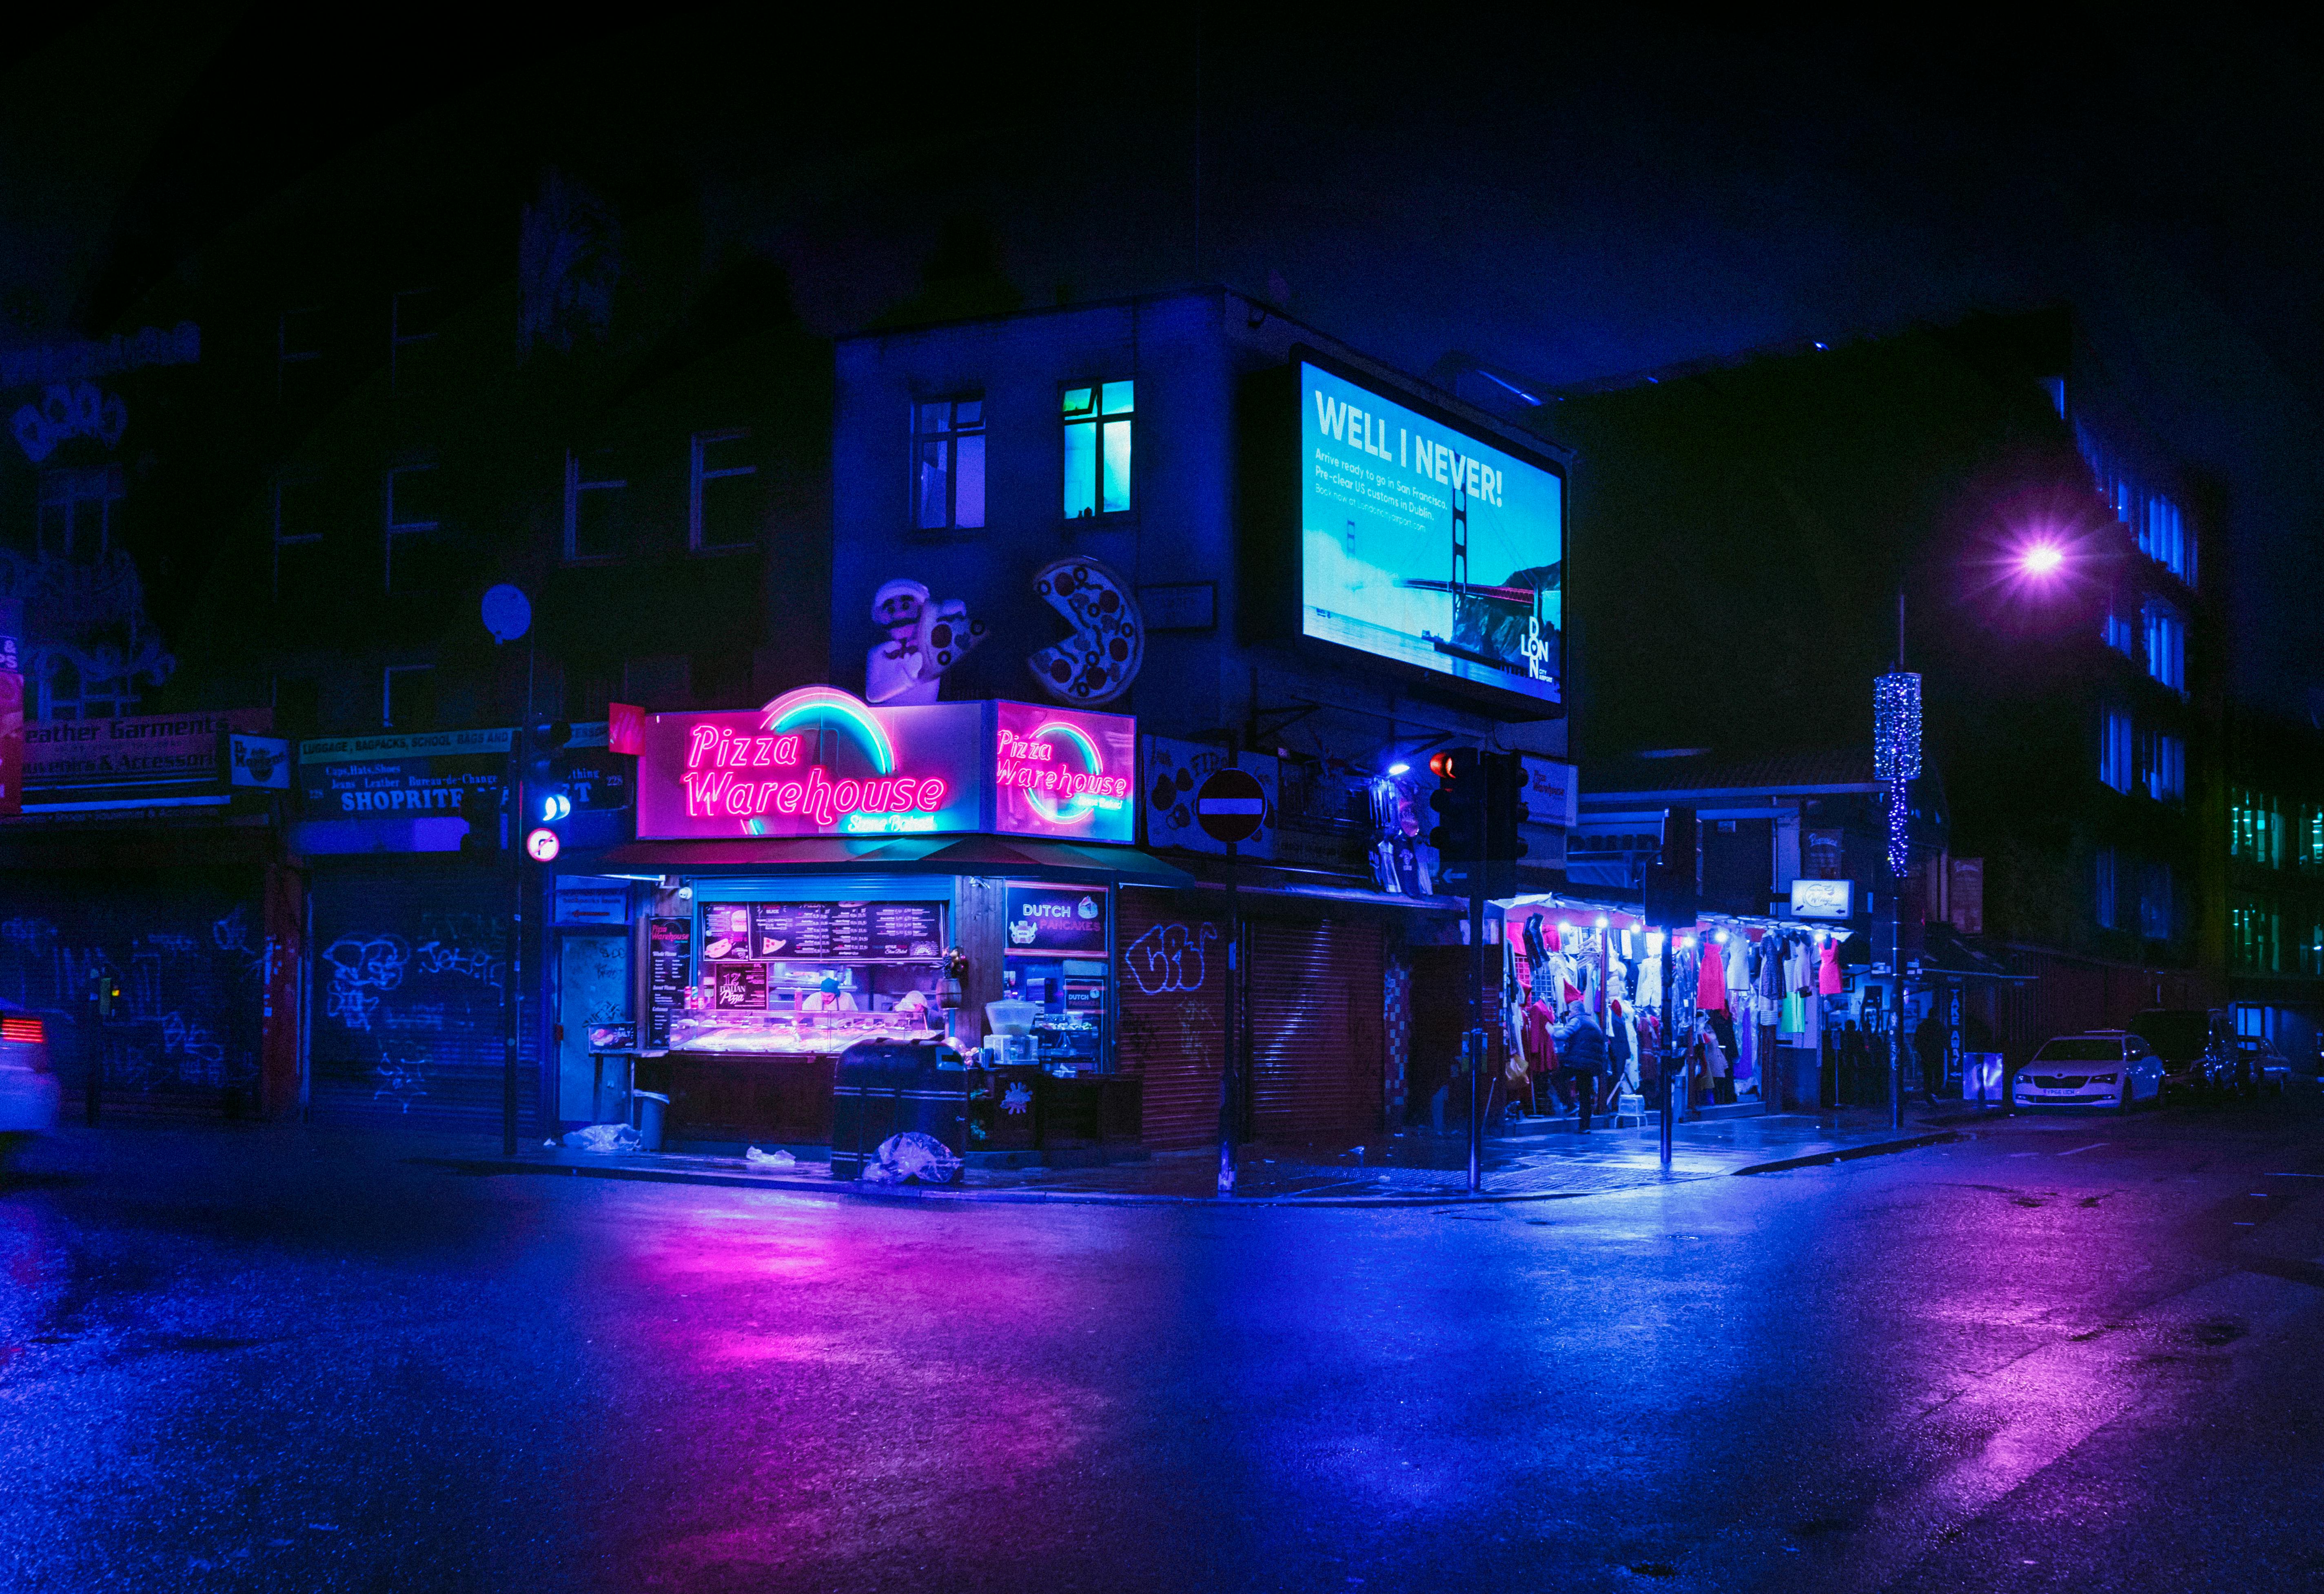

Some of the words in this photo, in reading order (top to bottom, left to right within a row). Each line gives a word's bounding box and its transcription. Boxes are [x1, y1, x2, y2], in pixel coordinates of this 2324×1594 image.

[1315, 390, 1392, 461] WELL
[1401, 428, 1406, 468] I
[1416, 435, 1502, 508] NEVER!
[1315, 448, 1339, 467] Arrive
[1342, 461, 1364, 479] ready
[1366, 470, 1374, 480] to
[1377, 475, 1386, 486] go
[1388, 477, 1394, 489] in
[1397, 481, 1410, 495] San
[1413, 487, 1447, 510] Francisco.
[1315, 465, 1353, 489] Pre-clear
[1355, 481, 1365, 494] US
[1367, 488, 1399, 507] customs
[1401, 499, 1407, 510] in
[1409, 501, 1434, 521] Dublin.
[1349, 498, 1356, 506] at
[25, 724, 100, 744] eather
[110, 717, 228, 740] Garments
[411, 735, 450, 748] SCHOOL
[457, 733, 483, 745] BAGS
[487, 732, 507, 743] AND
[689, 725, 798, 767] Pizza
[997, 729, 1051, 760] Pizza
[99, 755, 113, 772] &
[122, 749, 216, 772] Accessori
[331, 778, 356, 789] Jeans
[364, 777, 400, 789] Leather
[996, 758, 1126, 798] Warehouse
[683, 768, 945, 825] Warehouse
[1023, 904, 1071, 918] DUTCH
[652, 931, 690, 942] Warehouse
[1040, 919, 1101, 932] PANCAKES
[723, 973, 741, 986] 12
[720, 989, 744, 1004] Pizza
[1950, 989, 1960, 1025] TAKE
